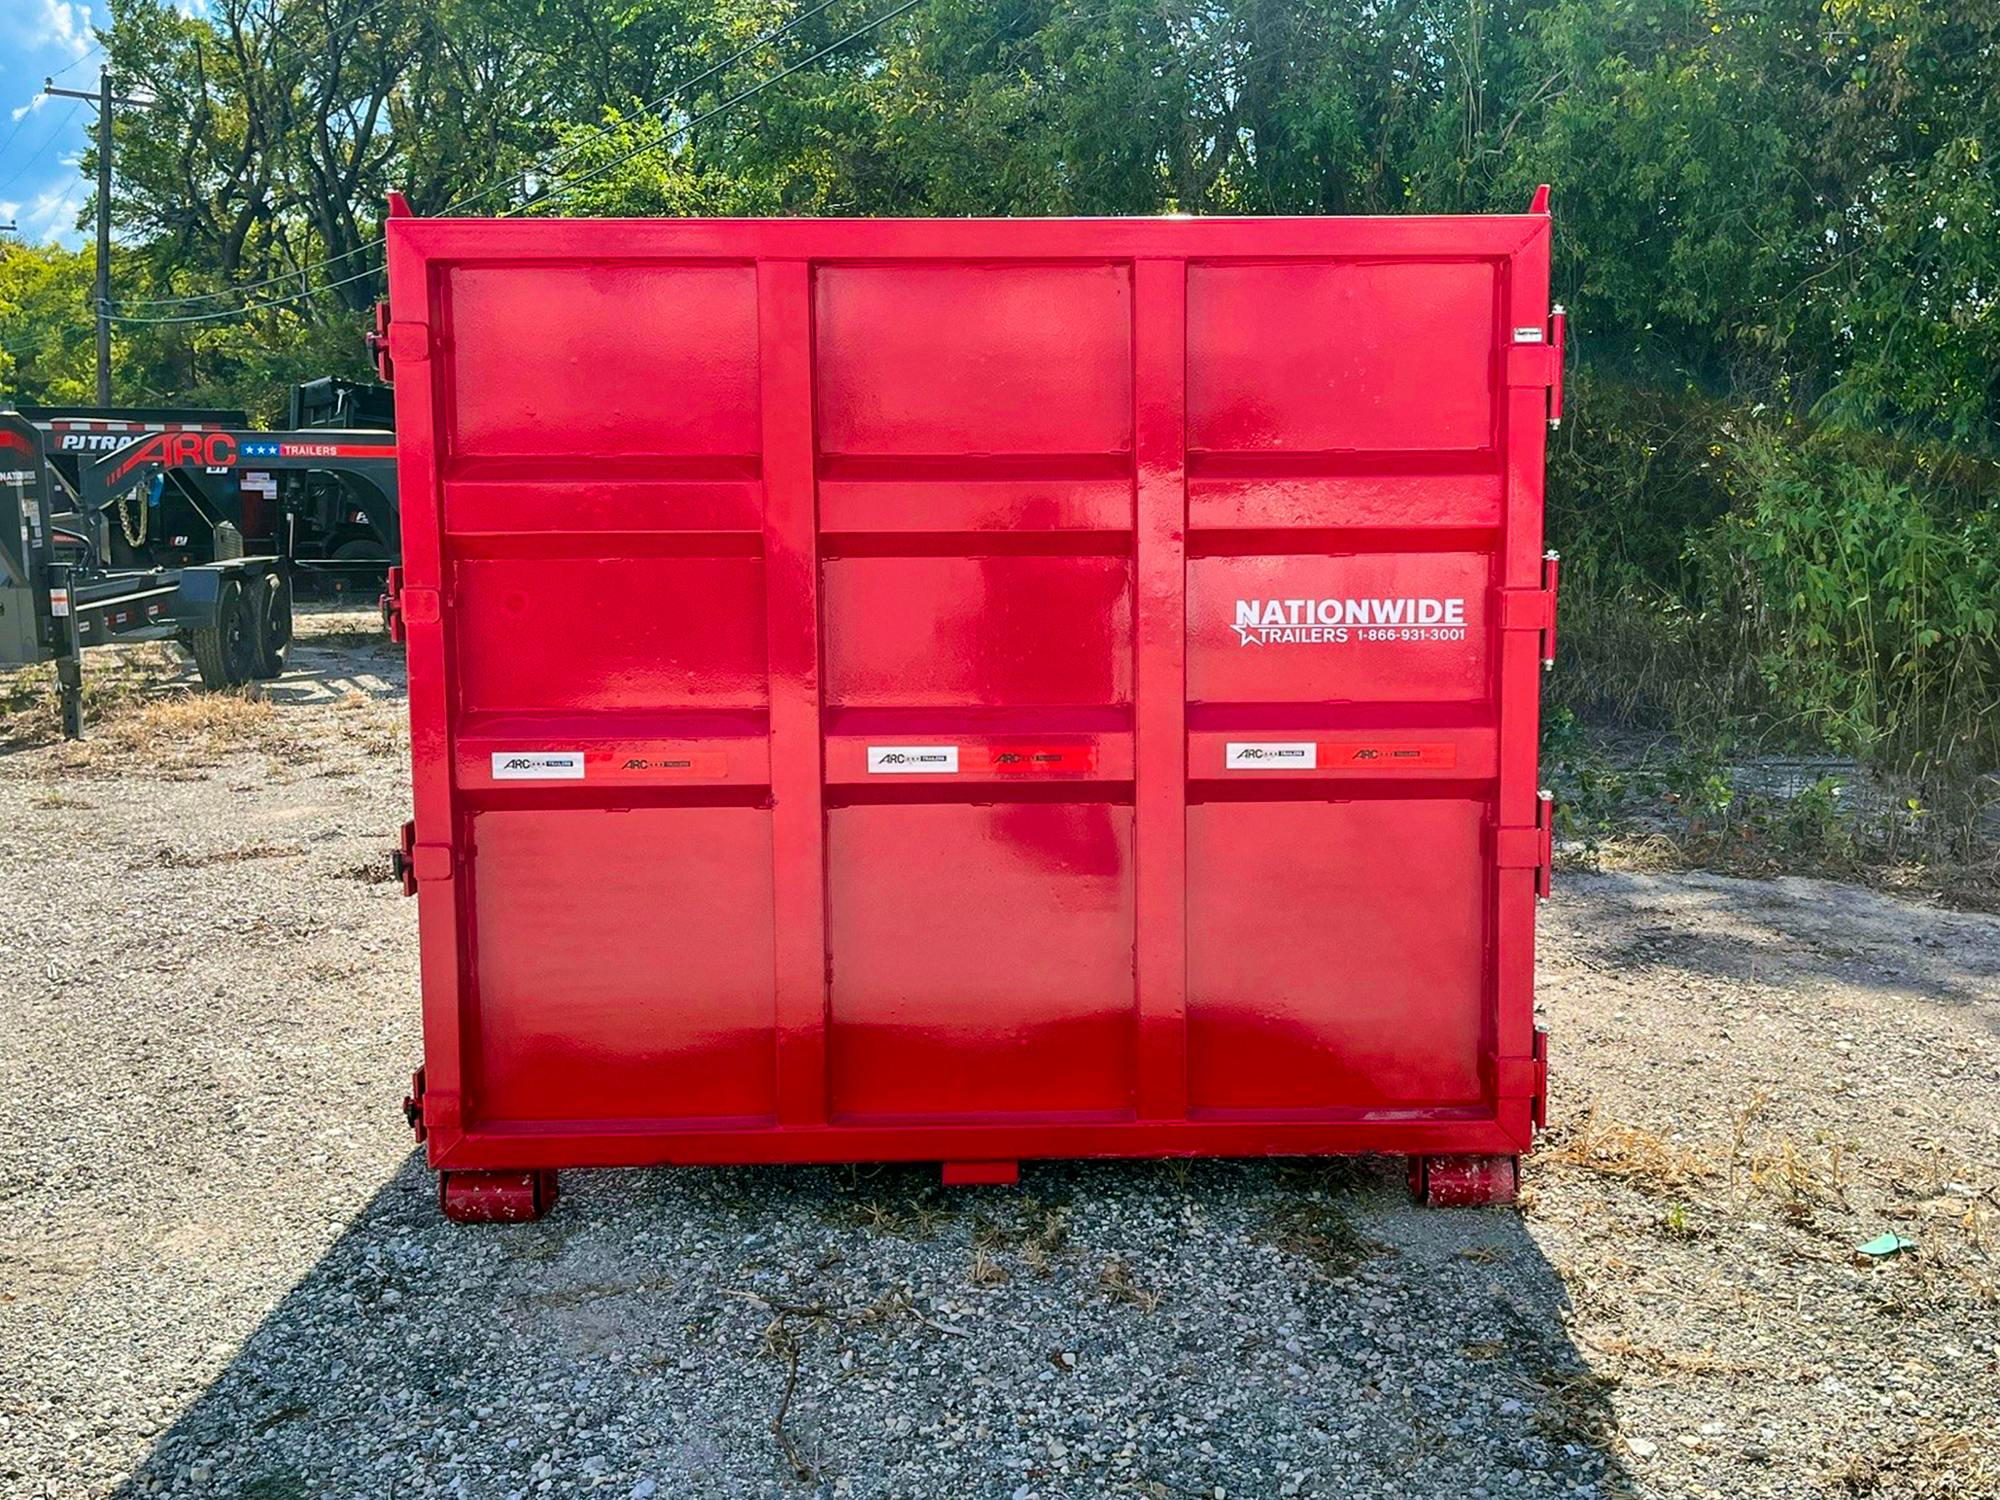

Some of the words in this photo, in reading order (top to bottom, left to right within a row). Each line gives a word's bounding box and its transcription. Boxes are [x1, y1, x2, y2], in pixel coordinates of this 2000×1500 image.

[88, 435, 136, 450] TRA
[108, 432, 237, 484] ARC
[284, 445, 337, 456] TRAILERS
[1235, 599, 1465, 625] NATIONWIDE
[1258, 628, 1348, 643] TRAILERS
[1357, 629, 1465, 641] 1-866-931-3001
[878, 754, 905, 764] ARC
[1237, 749, 1263, 759] ARC
[1352, 749, 1378, 759] ARC
[504, 759, 530, 769] ARC
[621, 759, 648, 769] ARC
